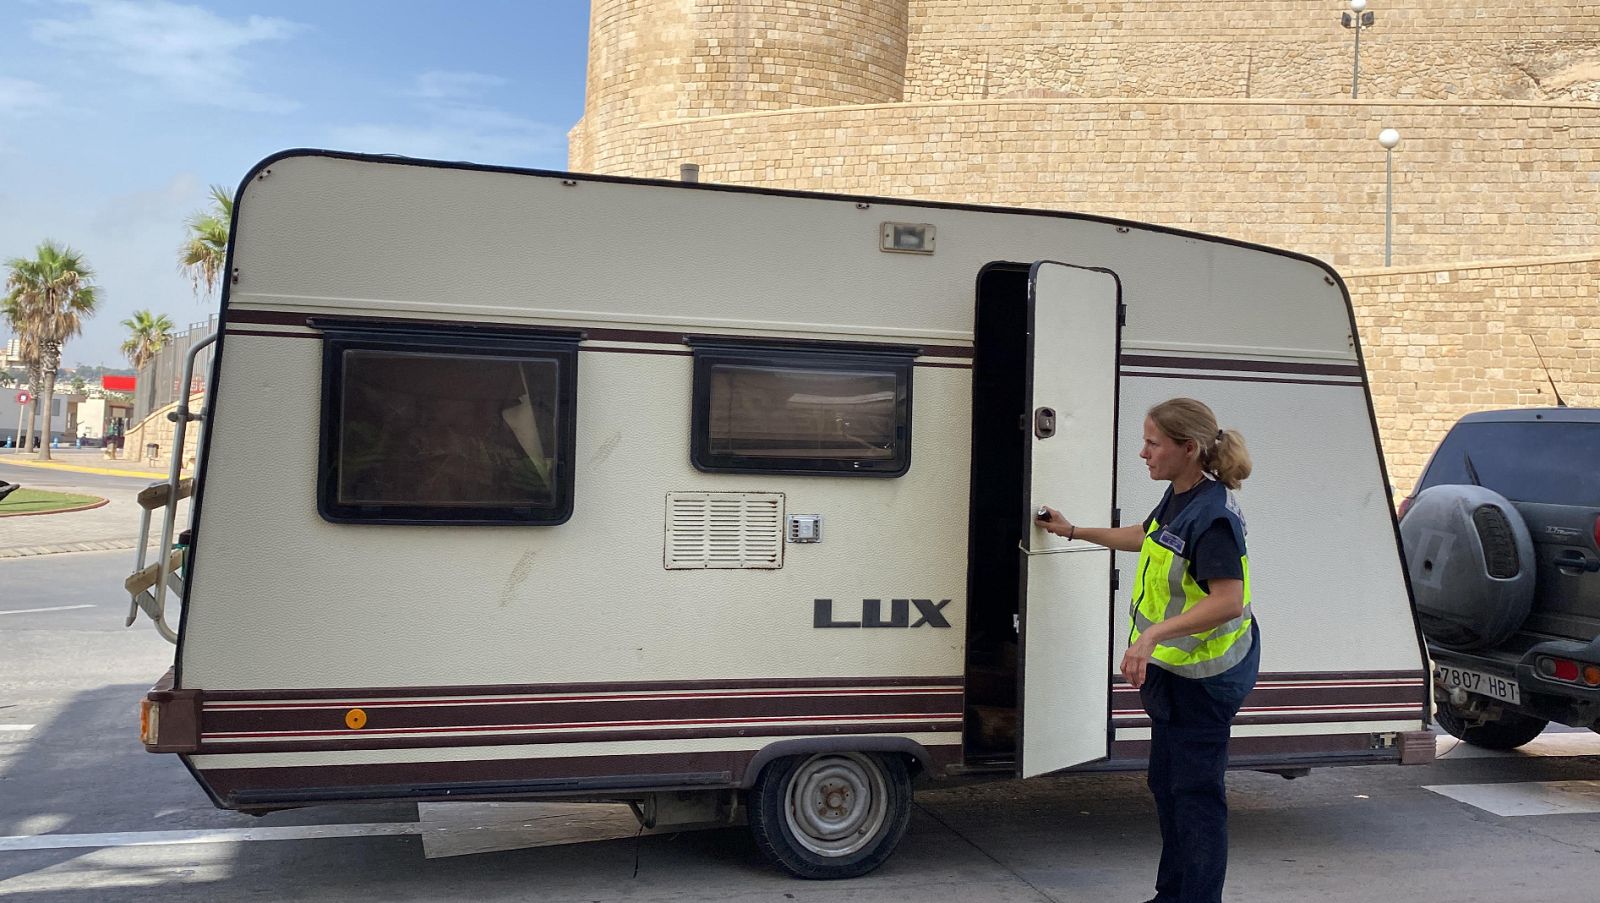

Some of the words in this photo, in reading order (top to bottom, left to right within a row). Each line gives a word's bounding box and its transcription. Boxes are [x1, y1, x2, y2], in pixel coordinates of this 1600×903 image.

[813, 598, 952, 628] LUX
[1440, 667, 1481, 690] 7807
[1488, 676, 1516, 701] HBT
